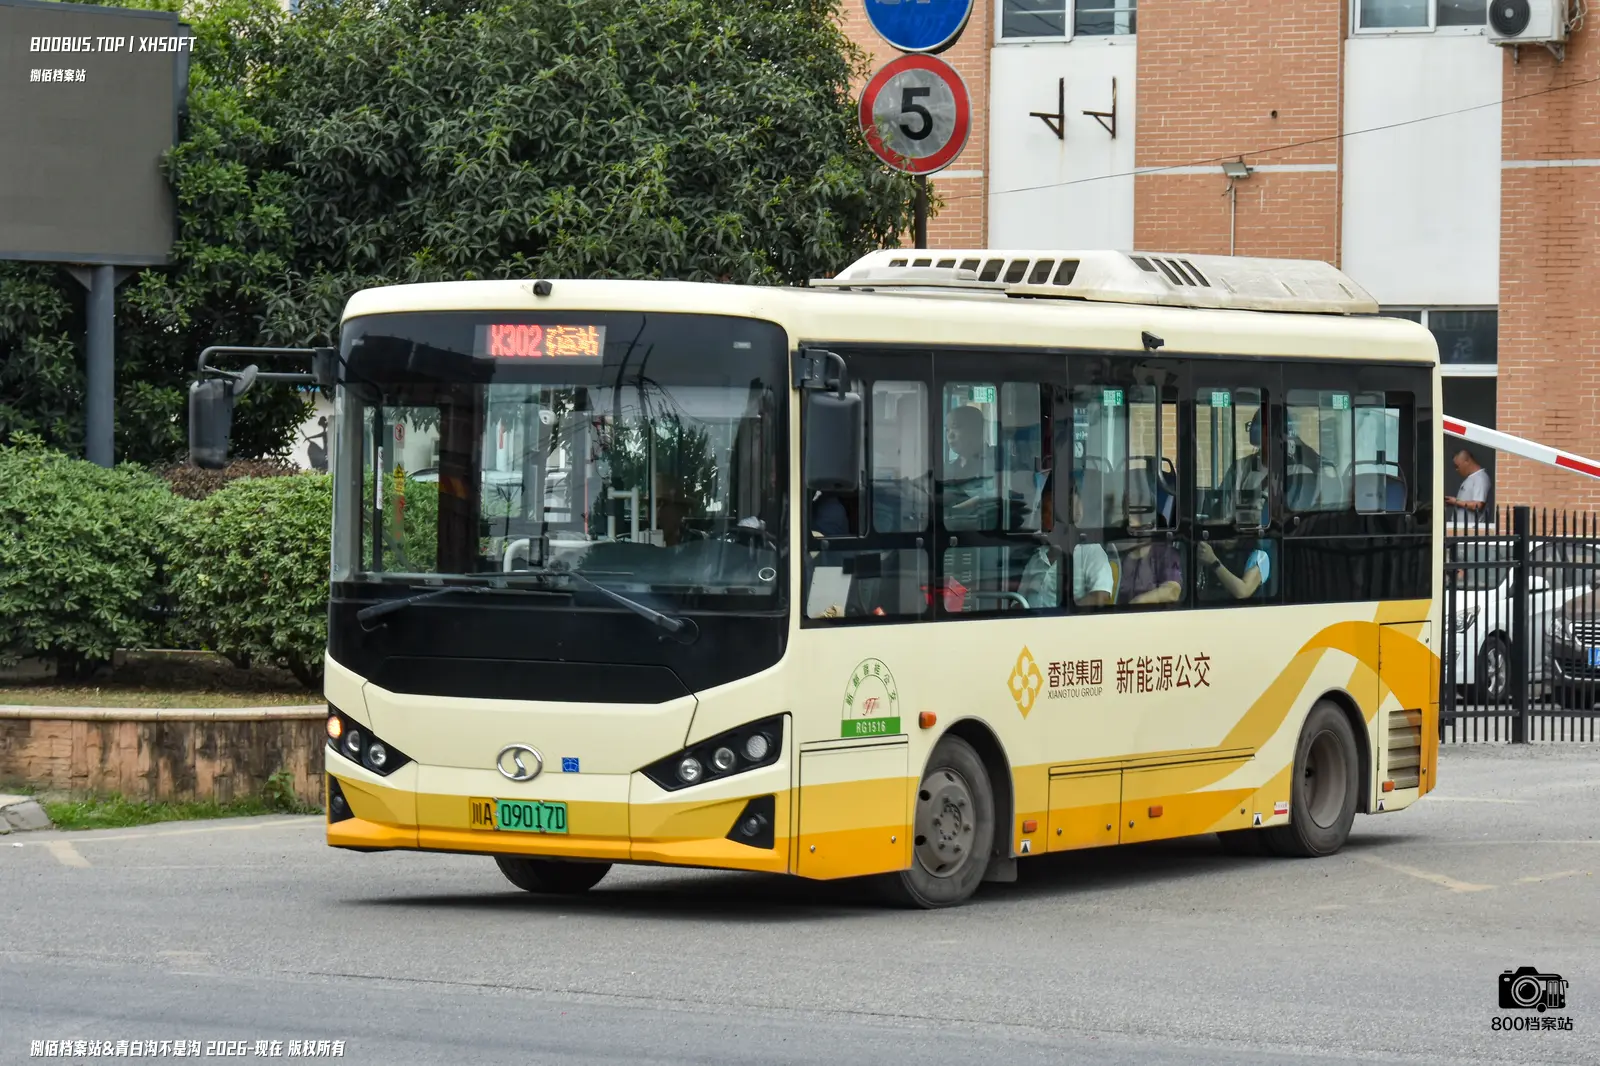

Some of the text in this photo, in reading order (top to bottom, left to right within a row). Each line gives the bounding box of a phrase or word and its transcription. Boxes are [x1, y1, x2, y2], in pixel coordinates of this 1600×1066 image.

[899, 87, 934, 141] 5
[490, 324, 543, 357] X302
[1047, 659, 1103, 689] 香投集团
[1116, 652, 1211, 695] 新能源公交
[1047, 686, 1103, 700] XIANGTOU GROUP
[856, 721, 887, 734] RG1516
[501, 803, 565, 830] 09017D
